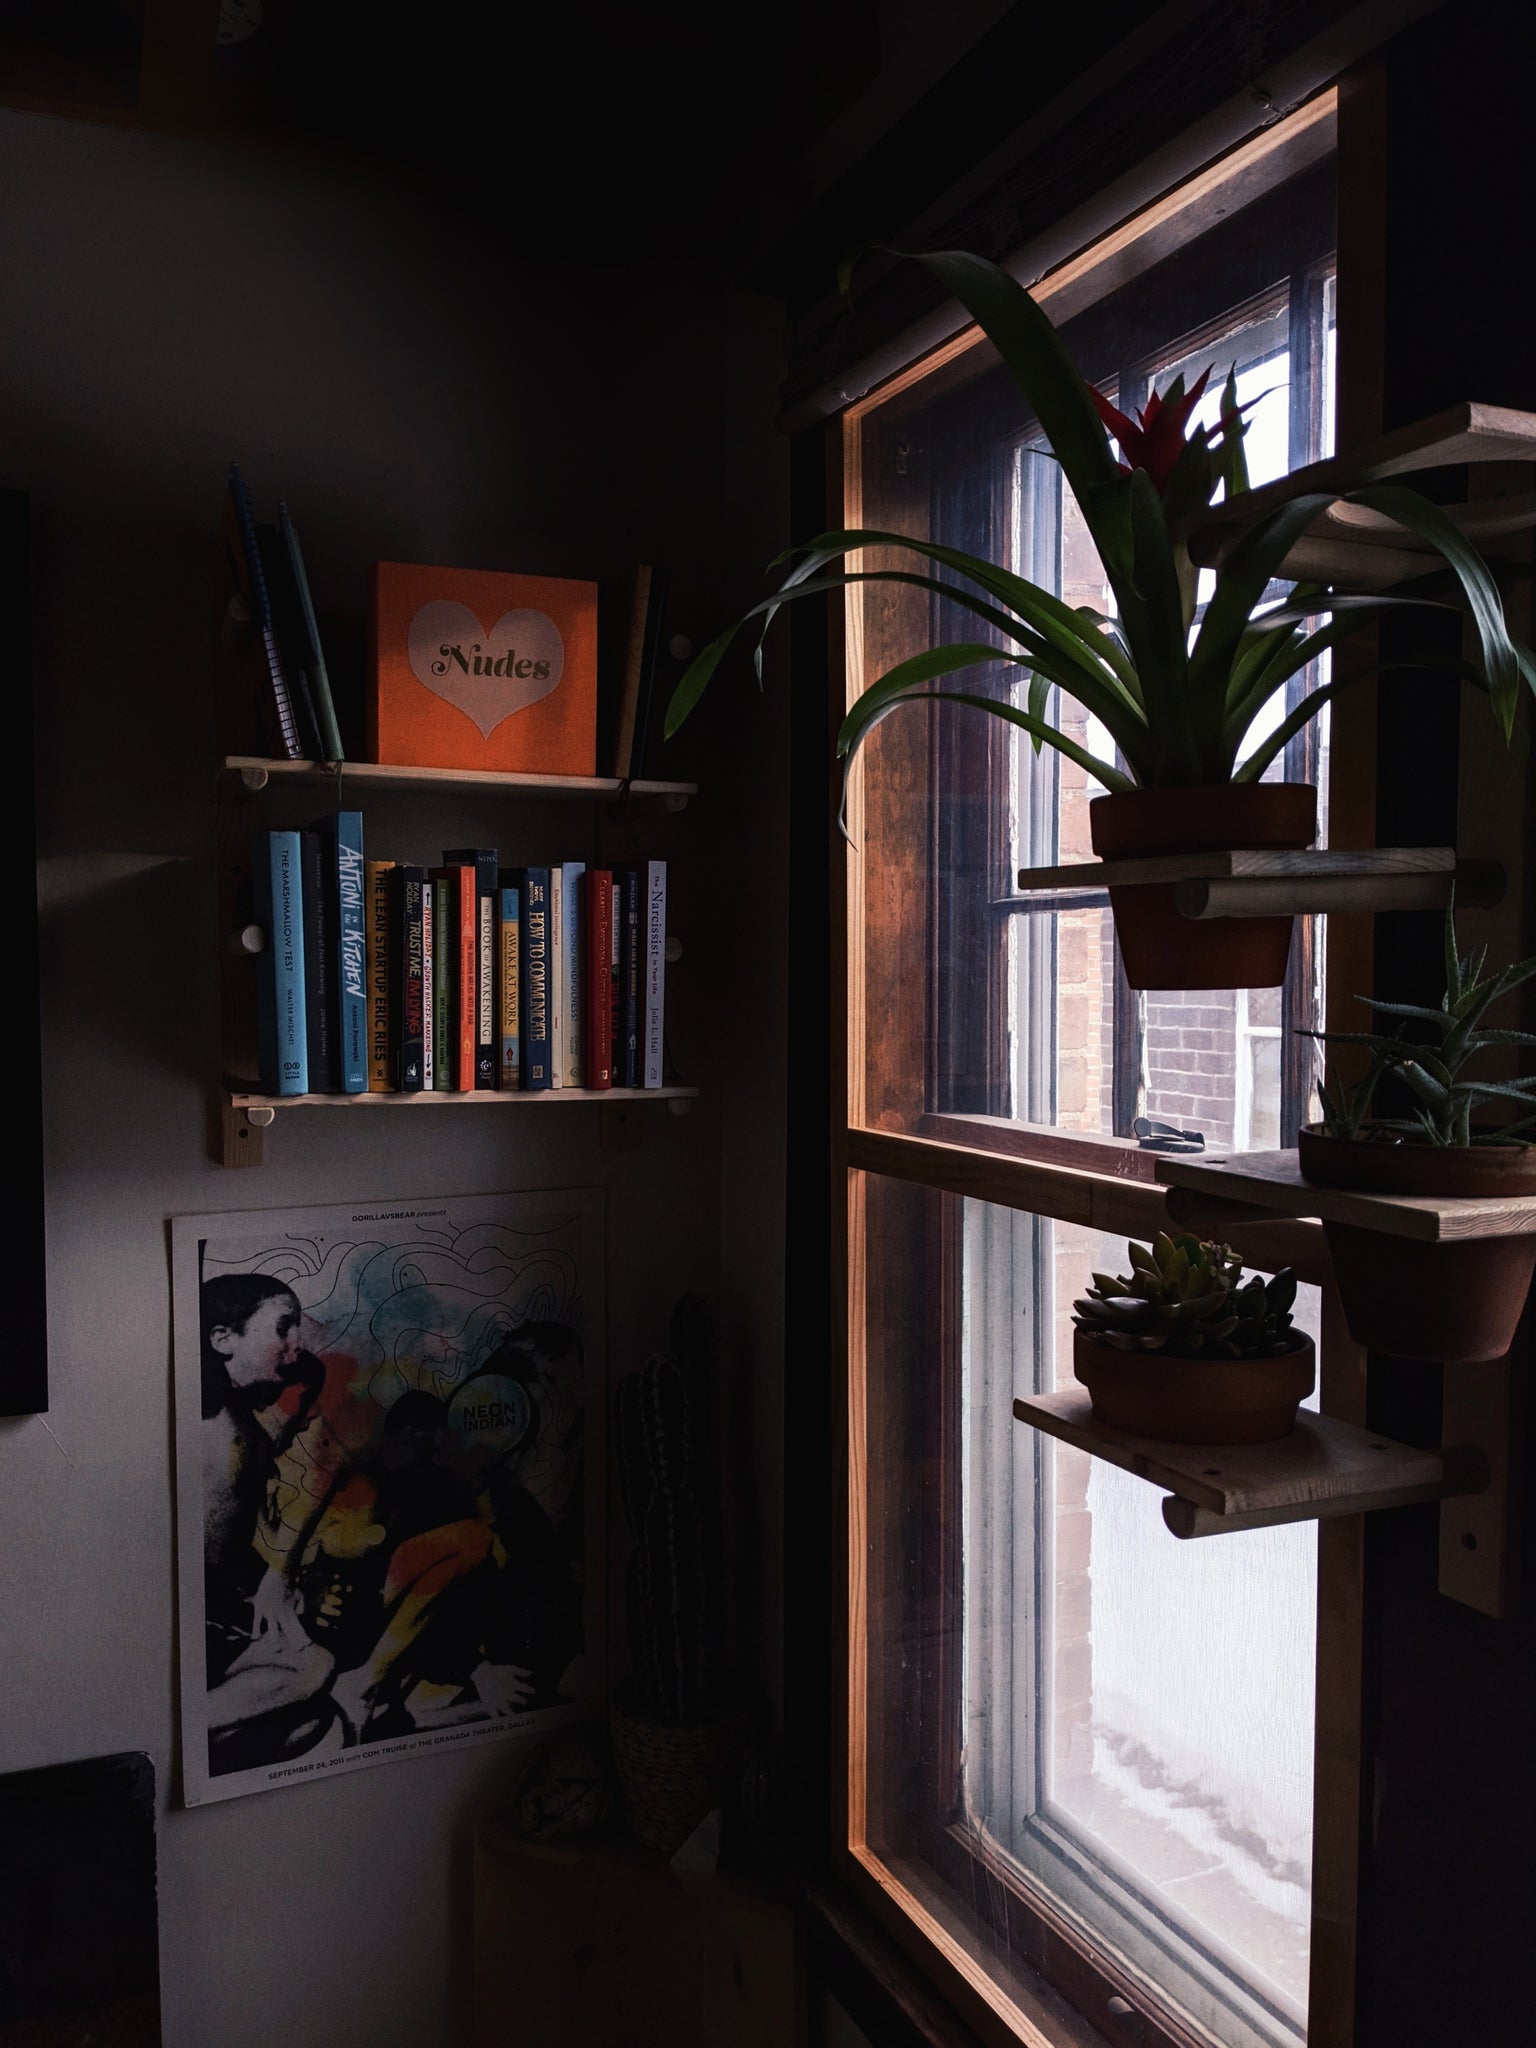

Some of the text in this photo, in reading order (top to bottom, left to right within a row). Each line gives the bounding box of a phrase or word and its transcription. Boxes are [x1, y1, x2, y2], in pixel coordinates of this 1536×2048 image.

[431, 644, 550, 680] Nudes
[281, 850, 293, 972] THE MARSHMALLOW TEST
[599, 879, 608, 918] CLEARING
[409, 920, 422, 954] TRUST
[424, 907, 433, 958] RYAN HOLIDAY
[482, 918, 491, 953] BOOK
[651, 890, 663, 955] Narcissist
[599, 921, 608, 966] EMOTIONAL
[375, 869, 387, 1061] THE LEAN STARTUP ERIC RIES
[424, 966, 432, 990] GROWTH
[508, 931, 517, 1026] AWAKE AT WORK
[529, 911, 546, 1041] HOW TO COMMUNICATE
[409, 998, 421, 1034] LYING
[482, 963, 492, 1038] AWAKENING
[651, 1007, 659, 1024] Julie
[352, 1030, 360, 1062] Porowski
[352, 1210, 446, 1222] GORILLAVSBEAR presents
[464, 1402, 515, 1420] NEON
[464, 1415, 515, 1432] INDIAN
[268, 1764, 314, 1780] SEPTEMBER
[316, 1761, 327, 1770] 24,
[329, 1757, 344, 1766] 2011
[362, 1750, 380, 1759] COM
[381, 1743, 408, 1755] TRUISE
[418, 1739, 433, 1748] THE
[434, 1732, 470, 1745] GRANADA
[472, 1725, 506, 1738] THEATER,
[508, 1718, 536, 1730] DALLAS
